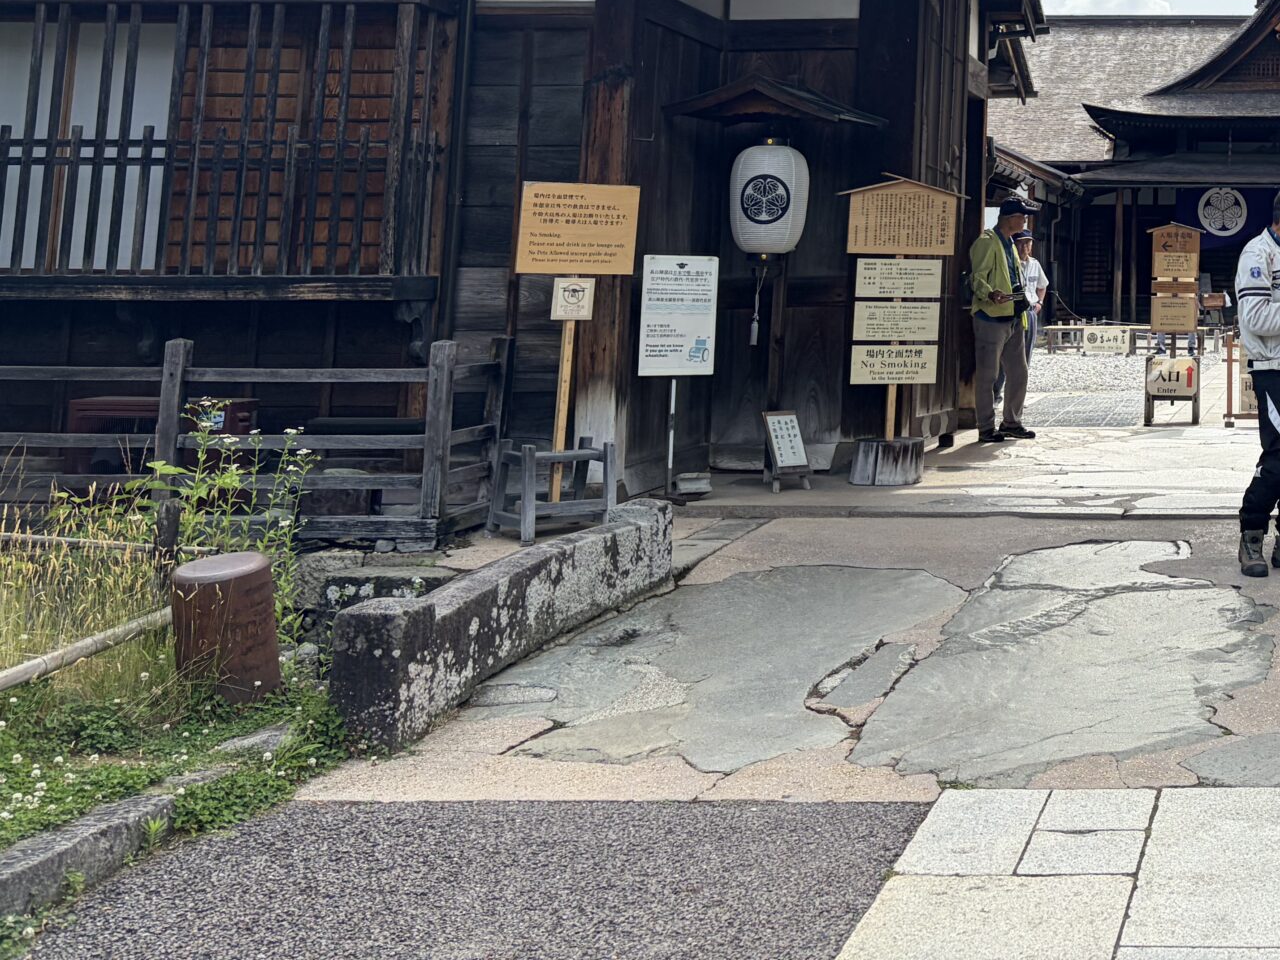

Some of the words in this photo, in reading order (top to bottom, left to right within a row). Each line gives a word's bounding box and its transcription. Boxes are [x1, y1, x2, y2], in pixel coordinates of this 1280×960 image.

[865, 349, 924, 359] 場内全面禁煙
[861, 360, 875, 369] No
[880, 360, 928, 370] Smoking
[1154, 369, 1180, 383] 入口
